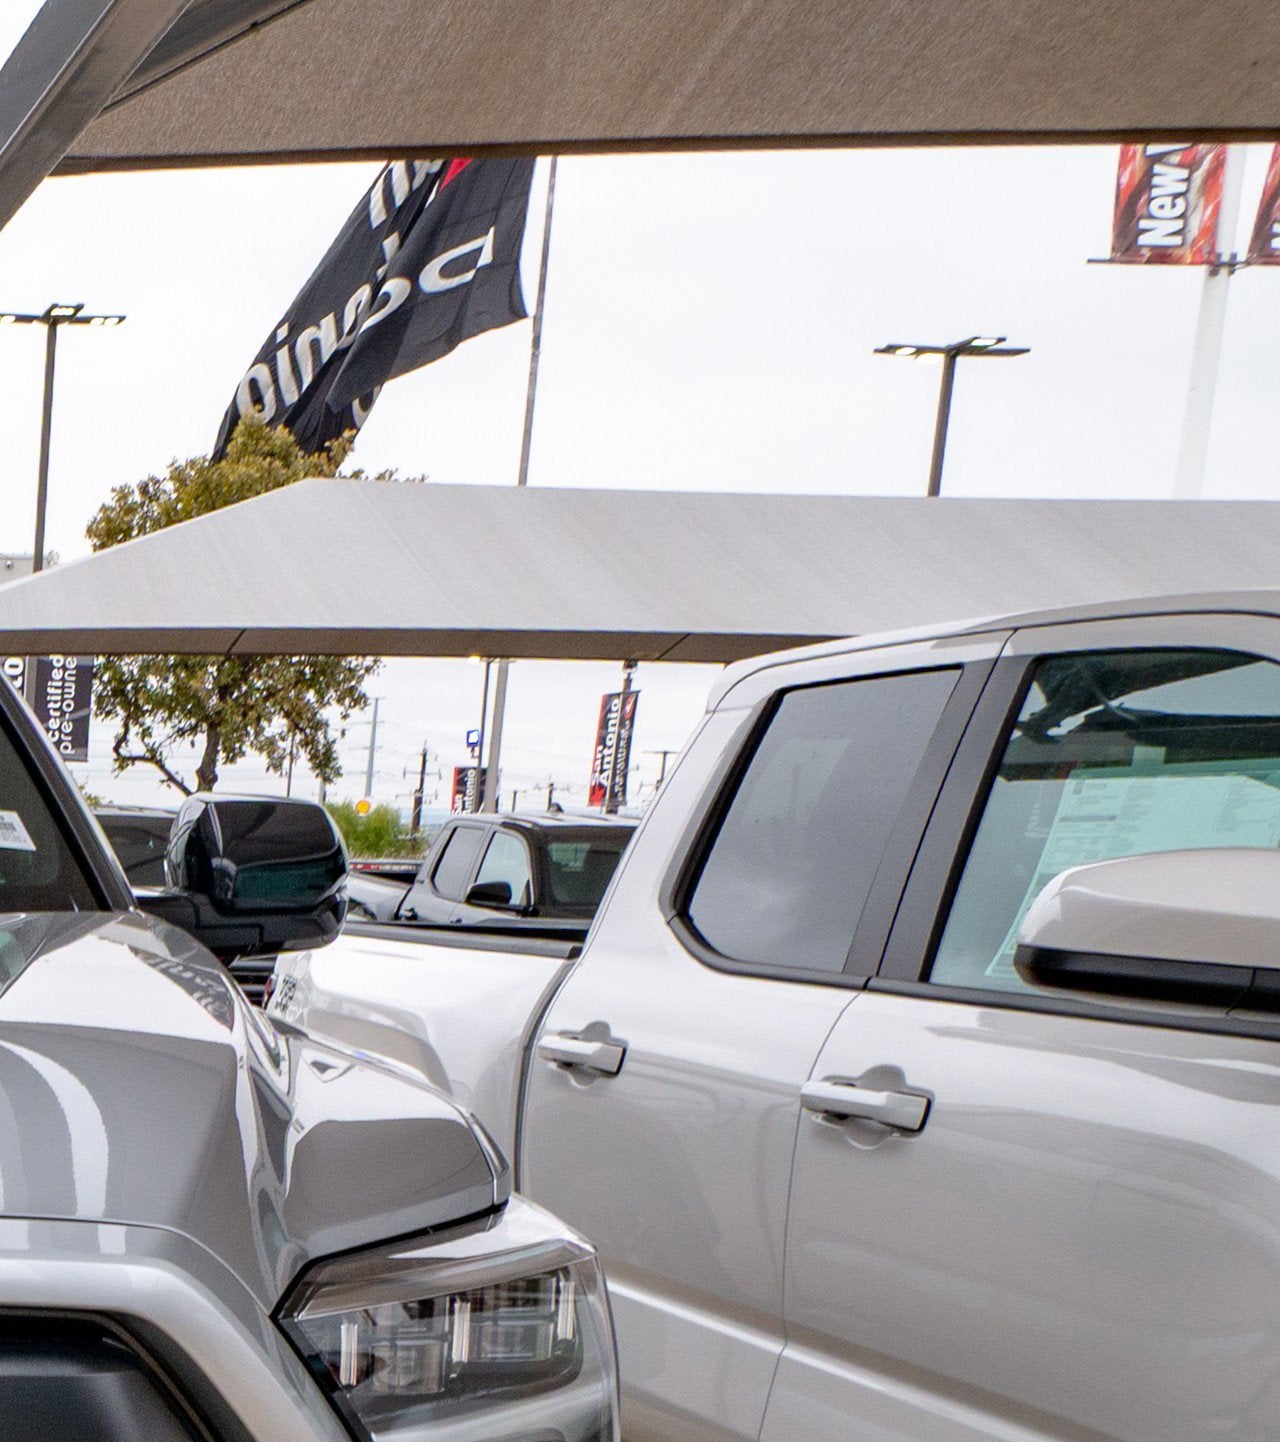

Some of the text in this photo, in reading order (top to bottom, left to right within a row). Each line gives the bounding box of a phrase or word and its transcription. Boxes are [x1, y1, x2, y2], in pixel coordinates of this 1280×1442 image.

[1137, 162, 1190, 247] New
[59, 656, 77, 755] pre-owne
[599, 698, 620, 787] Antonio
[591, 745, 604, 786] San
